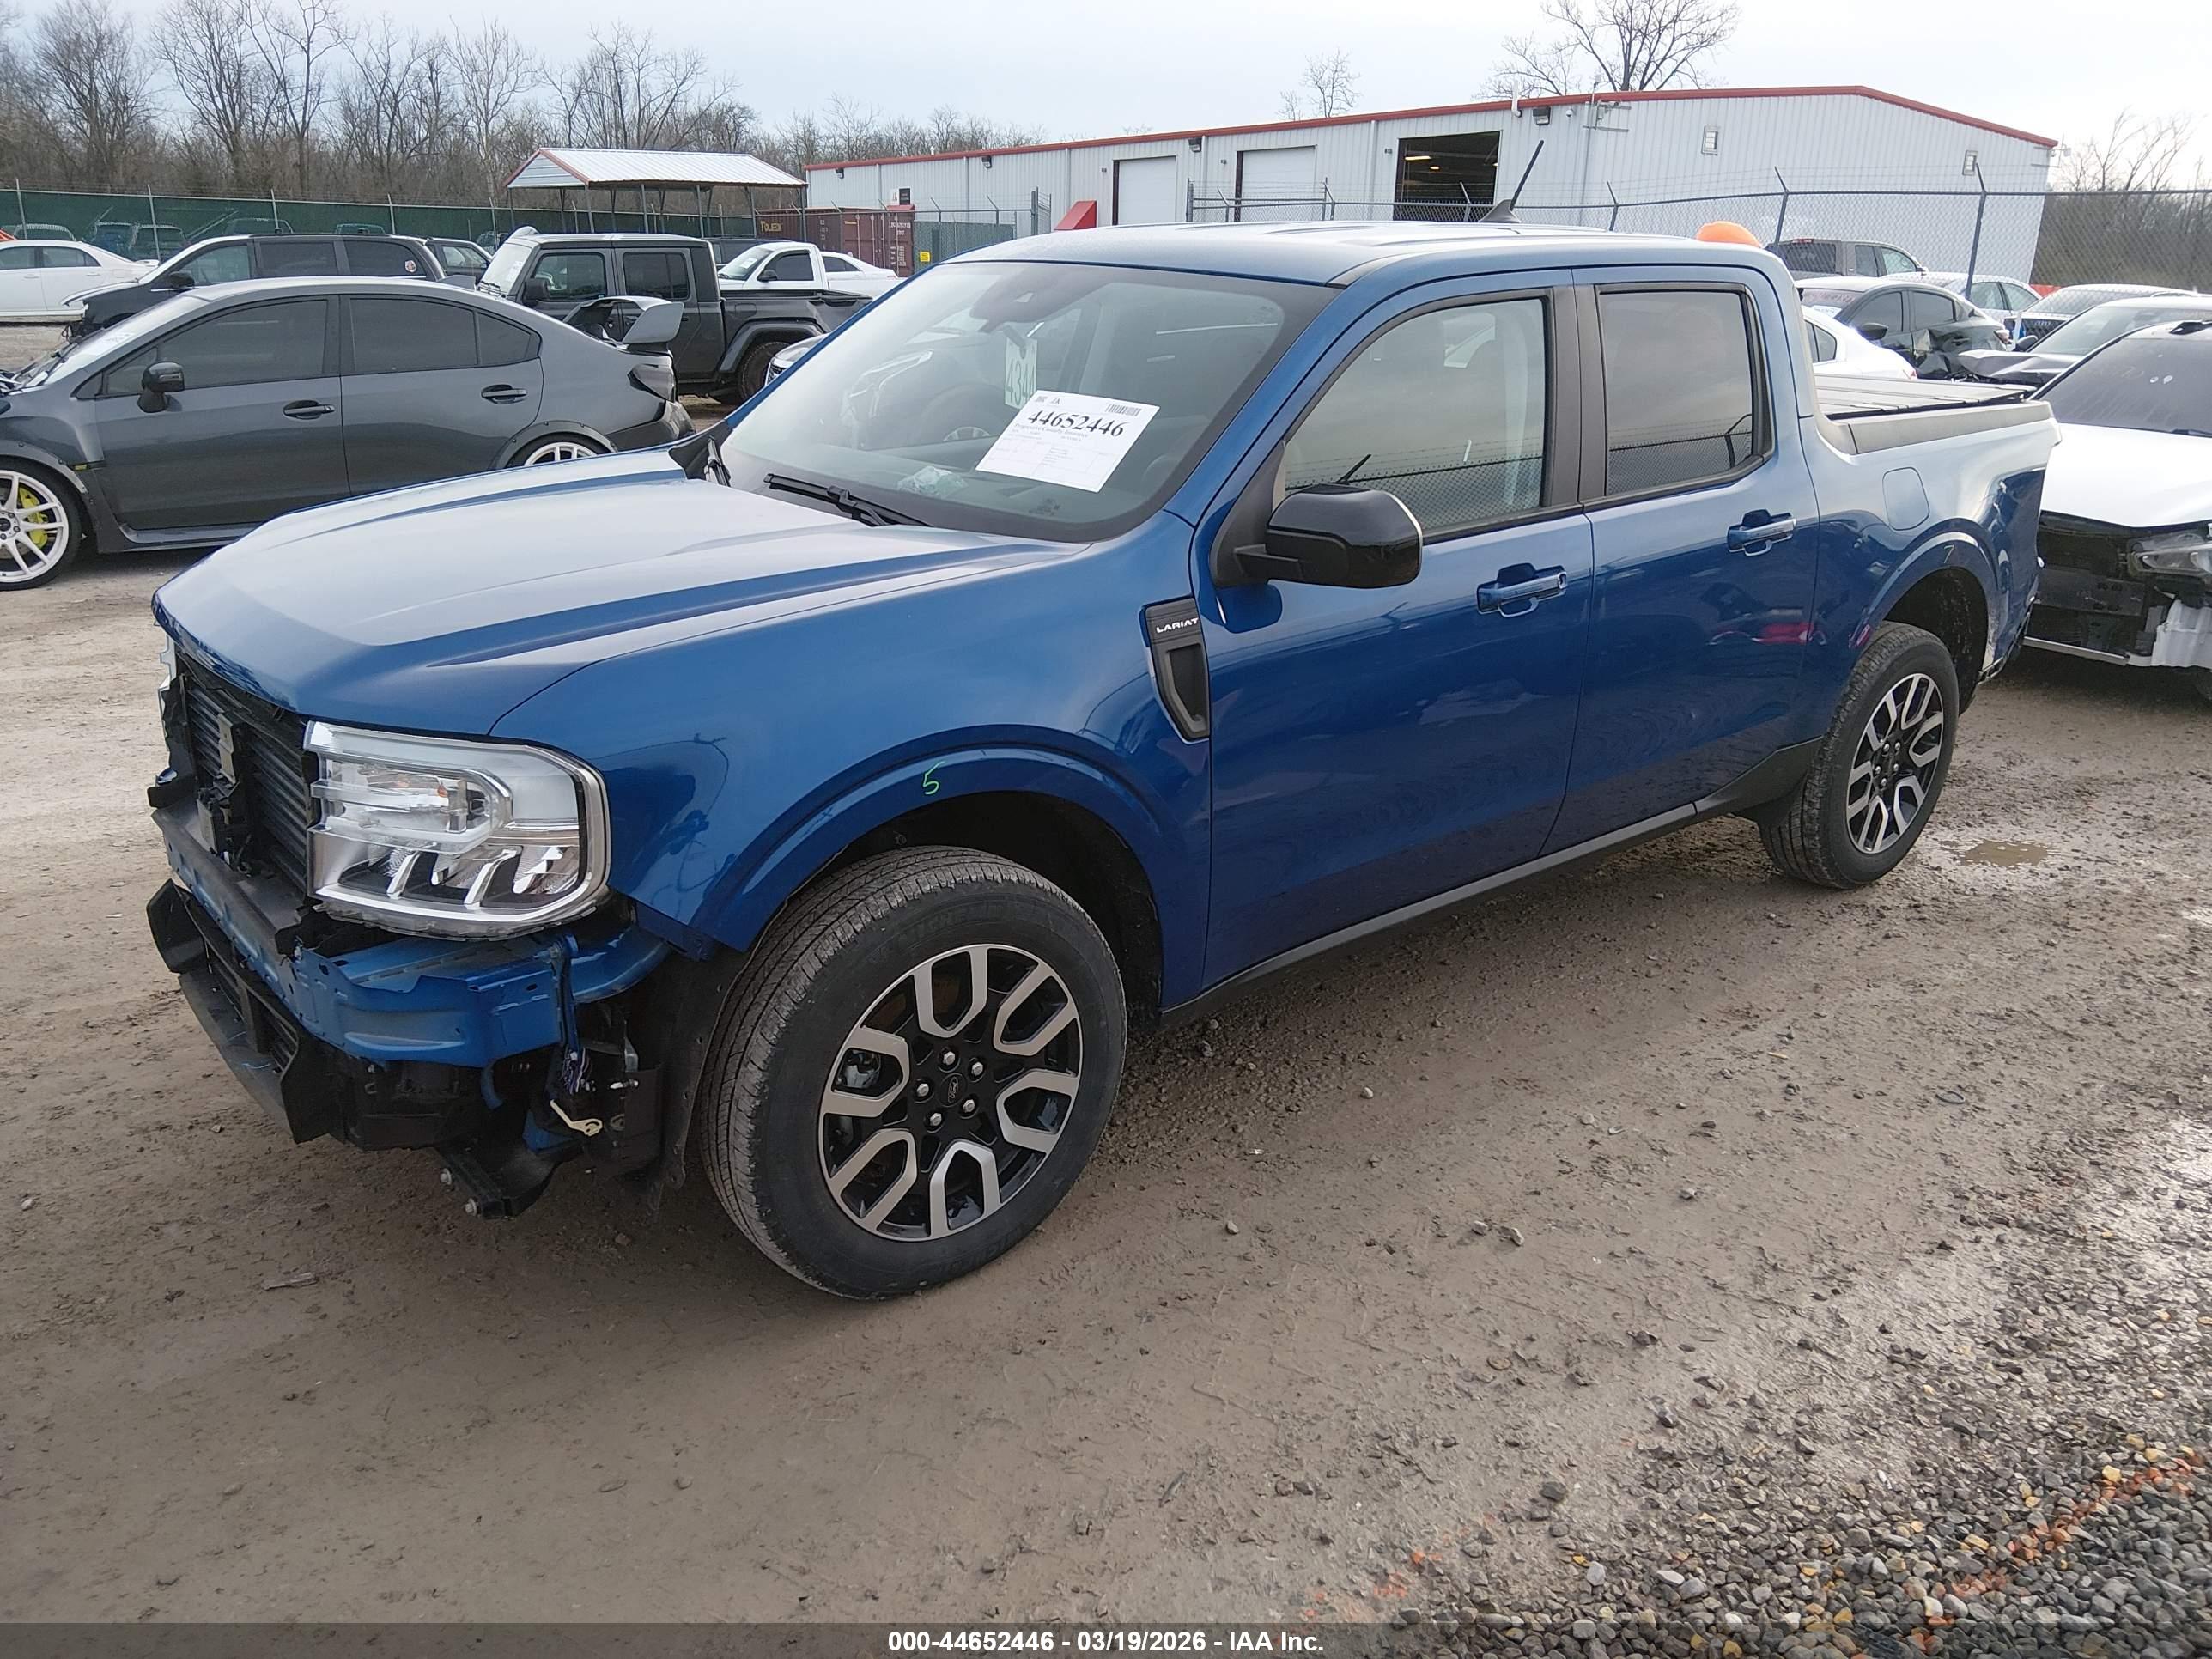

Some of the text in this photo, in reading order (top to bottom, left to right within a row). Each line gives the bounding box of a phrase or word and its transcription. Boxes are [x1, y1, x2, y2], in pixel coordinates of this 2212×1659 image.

[1027, 409, 1131, 437] 44652446
[1156, 617, 1199, 634] LARIAT
[922, 761, 945, 795] 5
